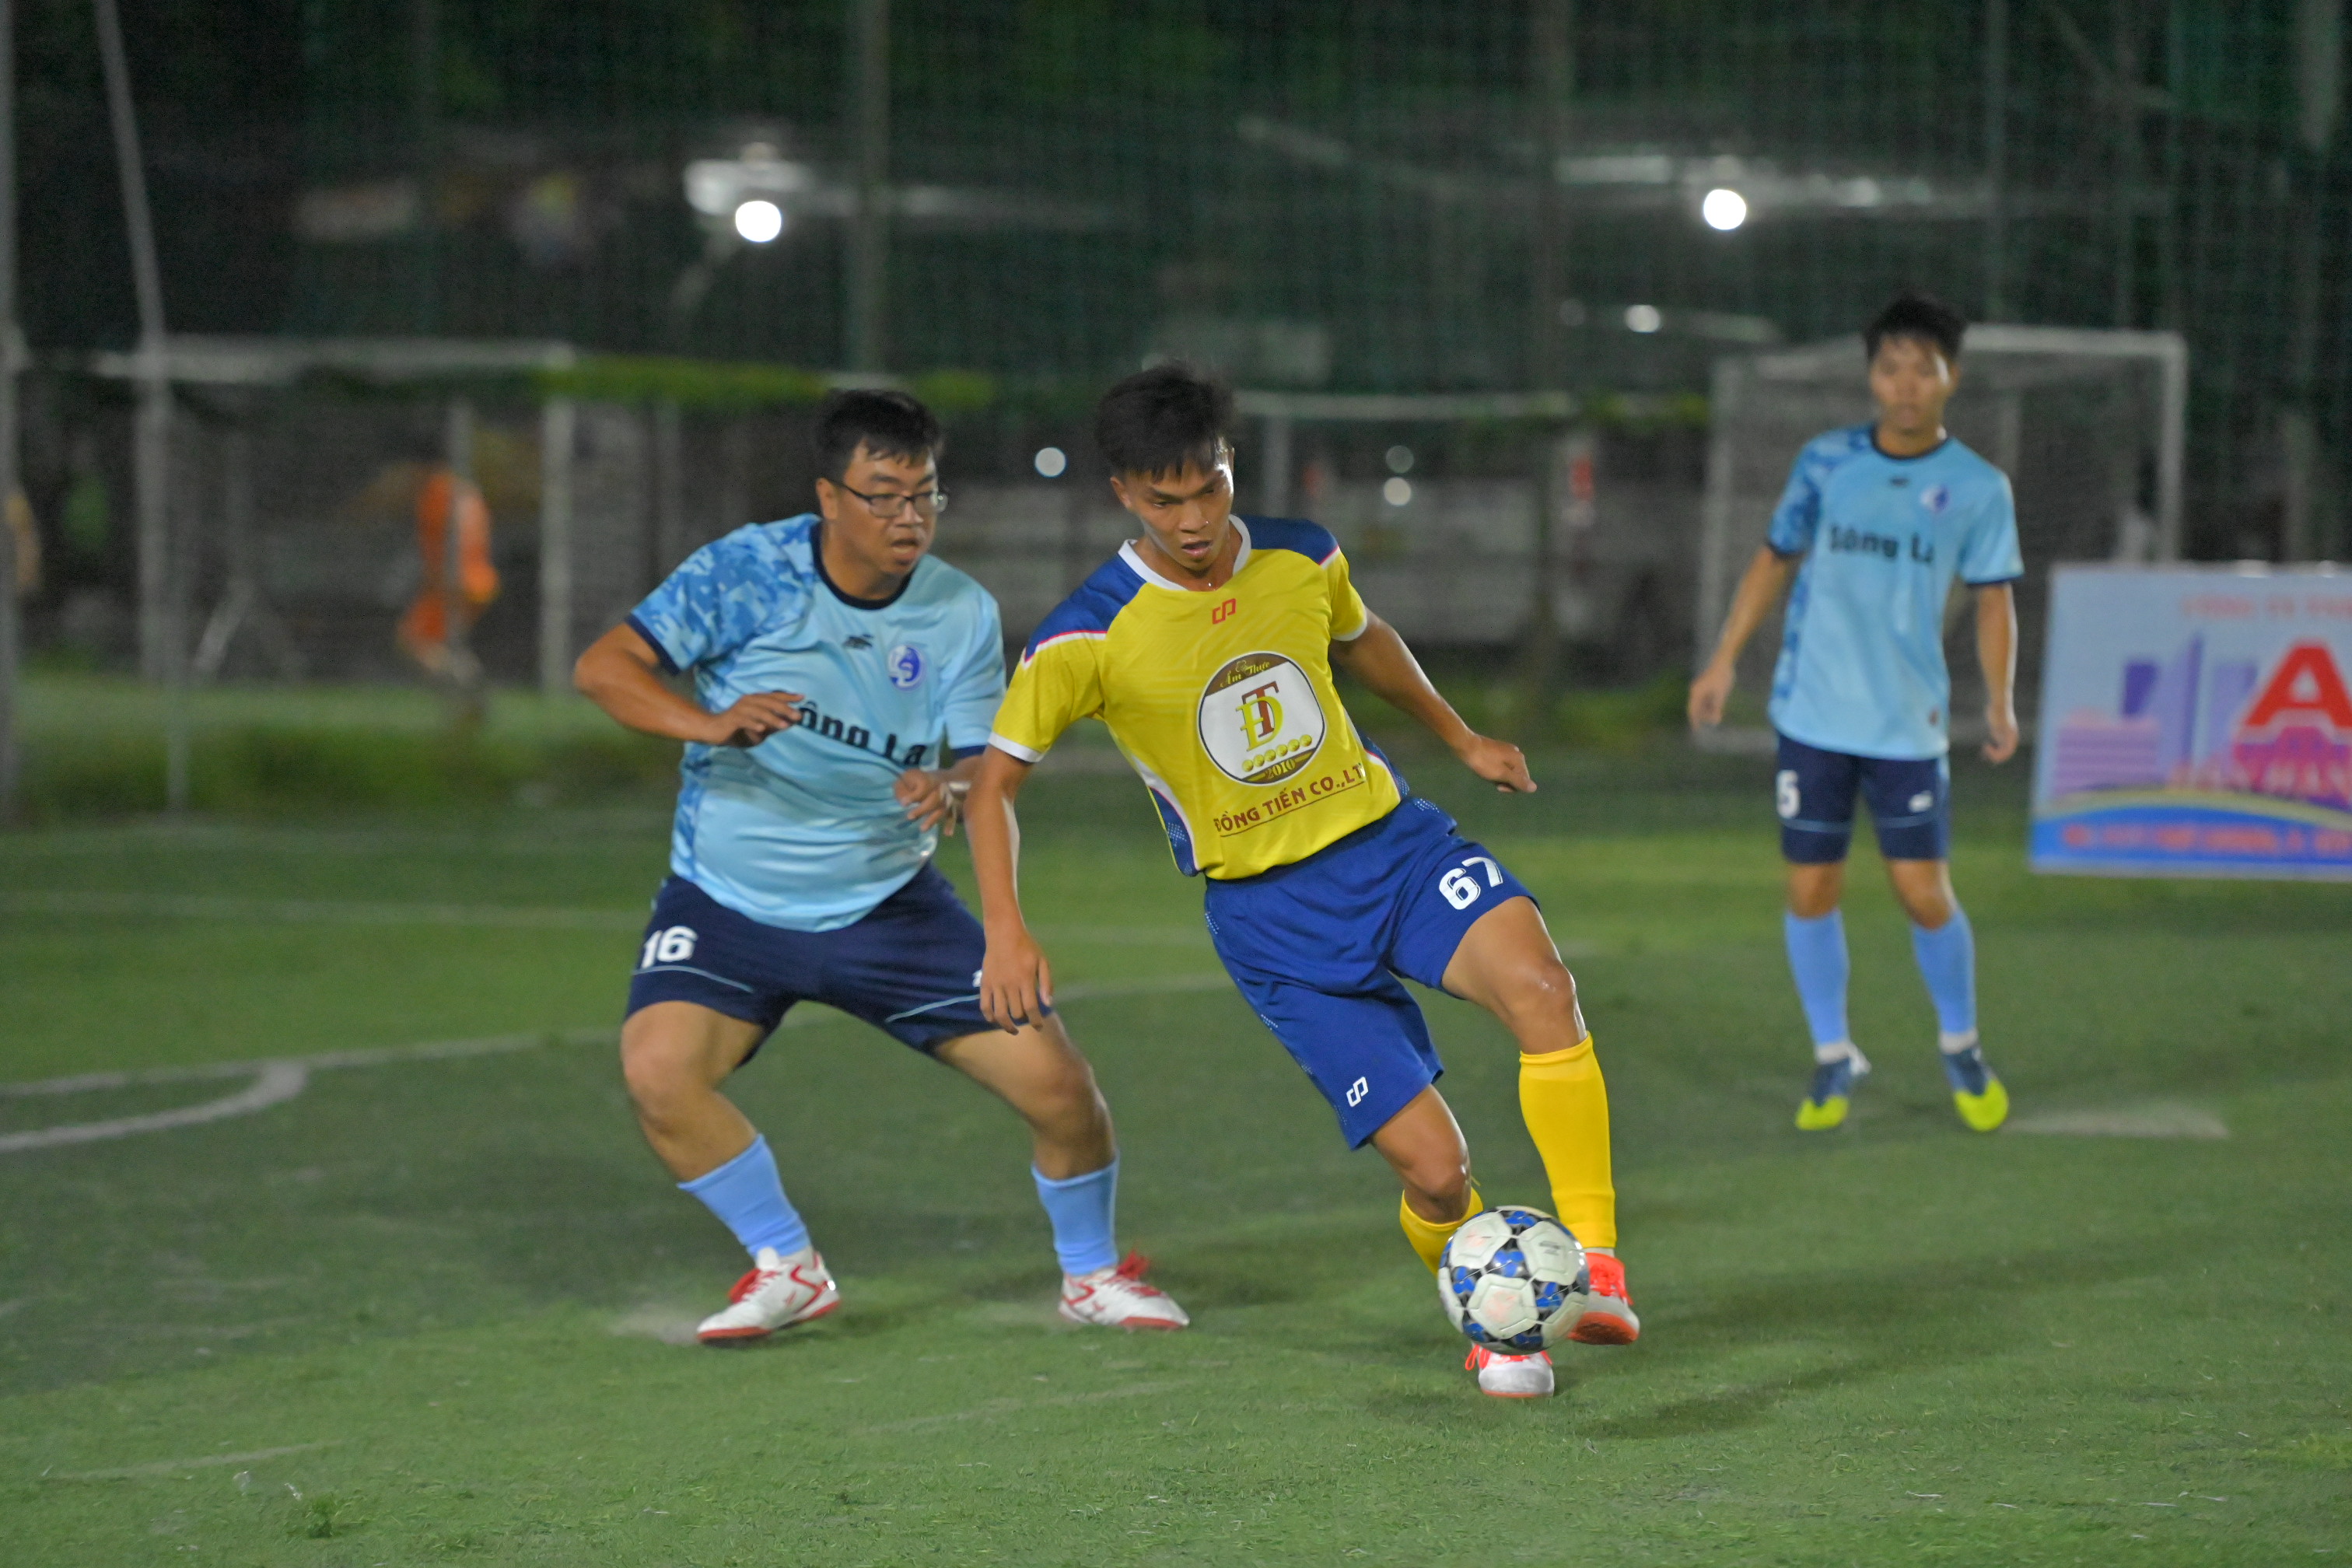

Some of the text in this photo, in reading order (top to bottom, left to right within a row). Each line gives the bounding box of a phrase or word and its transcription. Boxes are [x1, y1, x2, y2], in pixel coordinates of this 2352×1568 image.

[797, 701, 870, 750] ông
[1265, 759, 1296, 779] 2010
[1262, 787, 1307, 816] TIẾN
[1438, 856, 1503, 910] 67
[641, 925, 698, 969] 16
